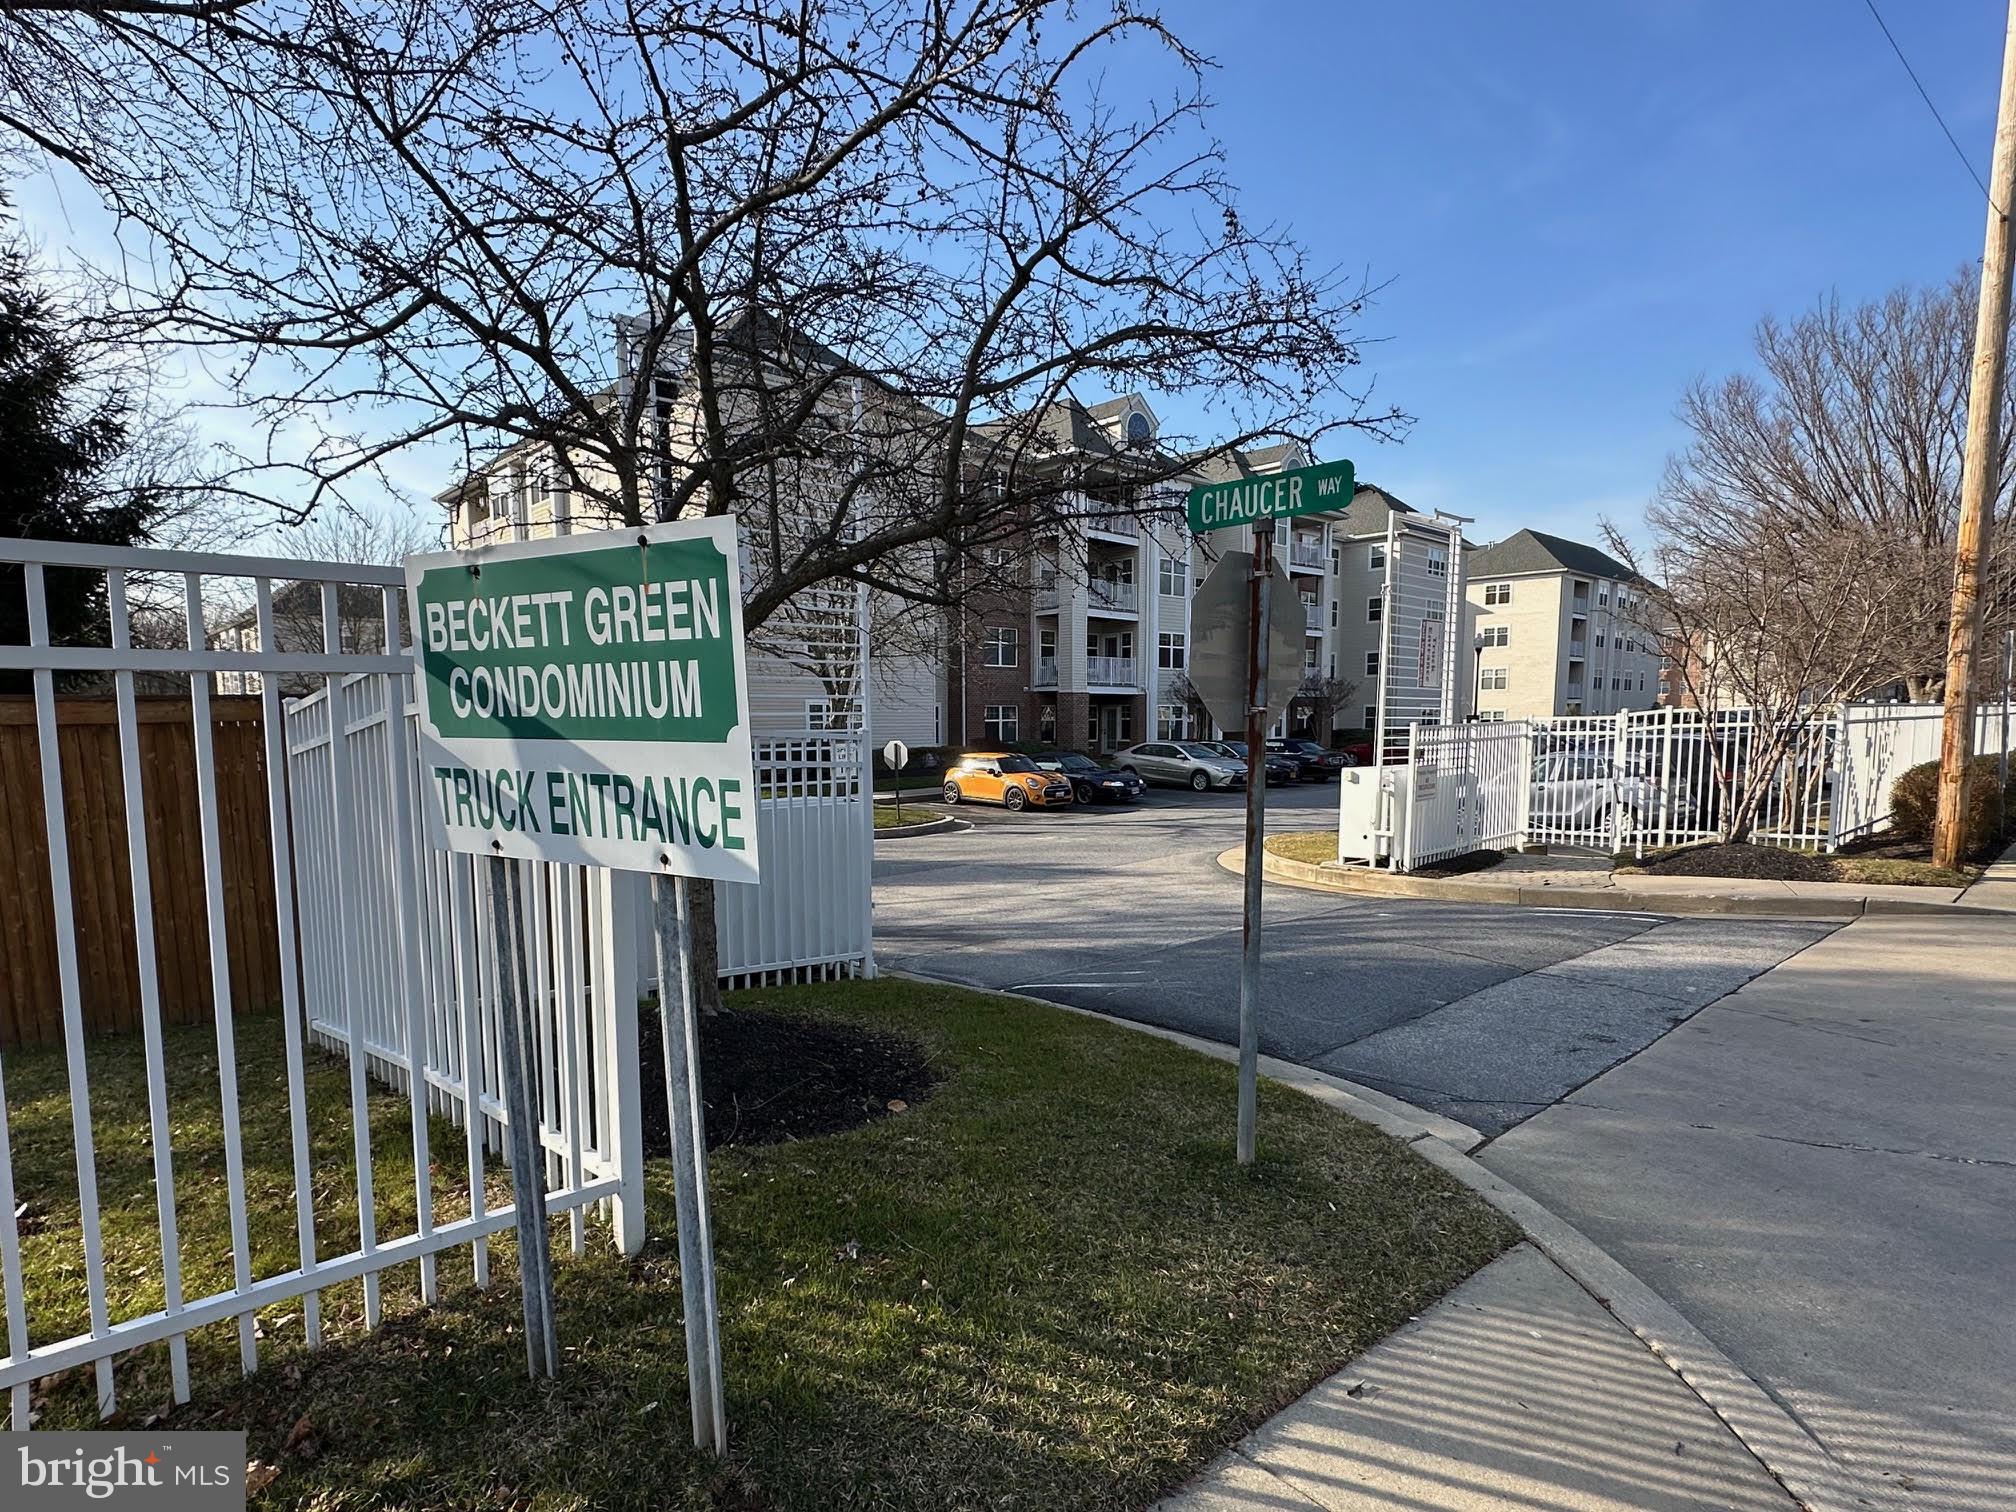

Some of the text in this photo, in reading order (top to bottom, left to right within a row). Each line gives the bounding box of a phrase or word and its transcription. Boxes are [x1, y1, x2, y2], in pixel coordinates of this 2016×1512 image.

[1201, 475, 1342, 524] CHAUCER WAY
[425, 577, 721, 652] BECKETT GREEN
[450, 660, 702, 719] CONDOMINIUM
[434, 767, 746, 851] TRUCK ENTRANCE
